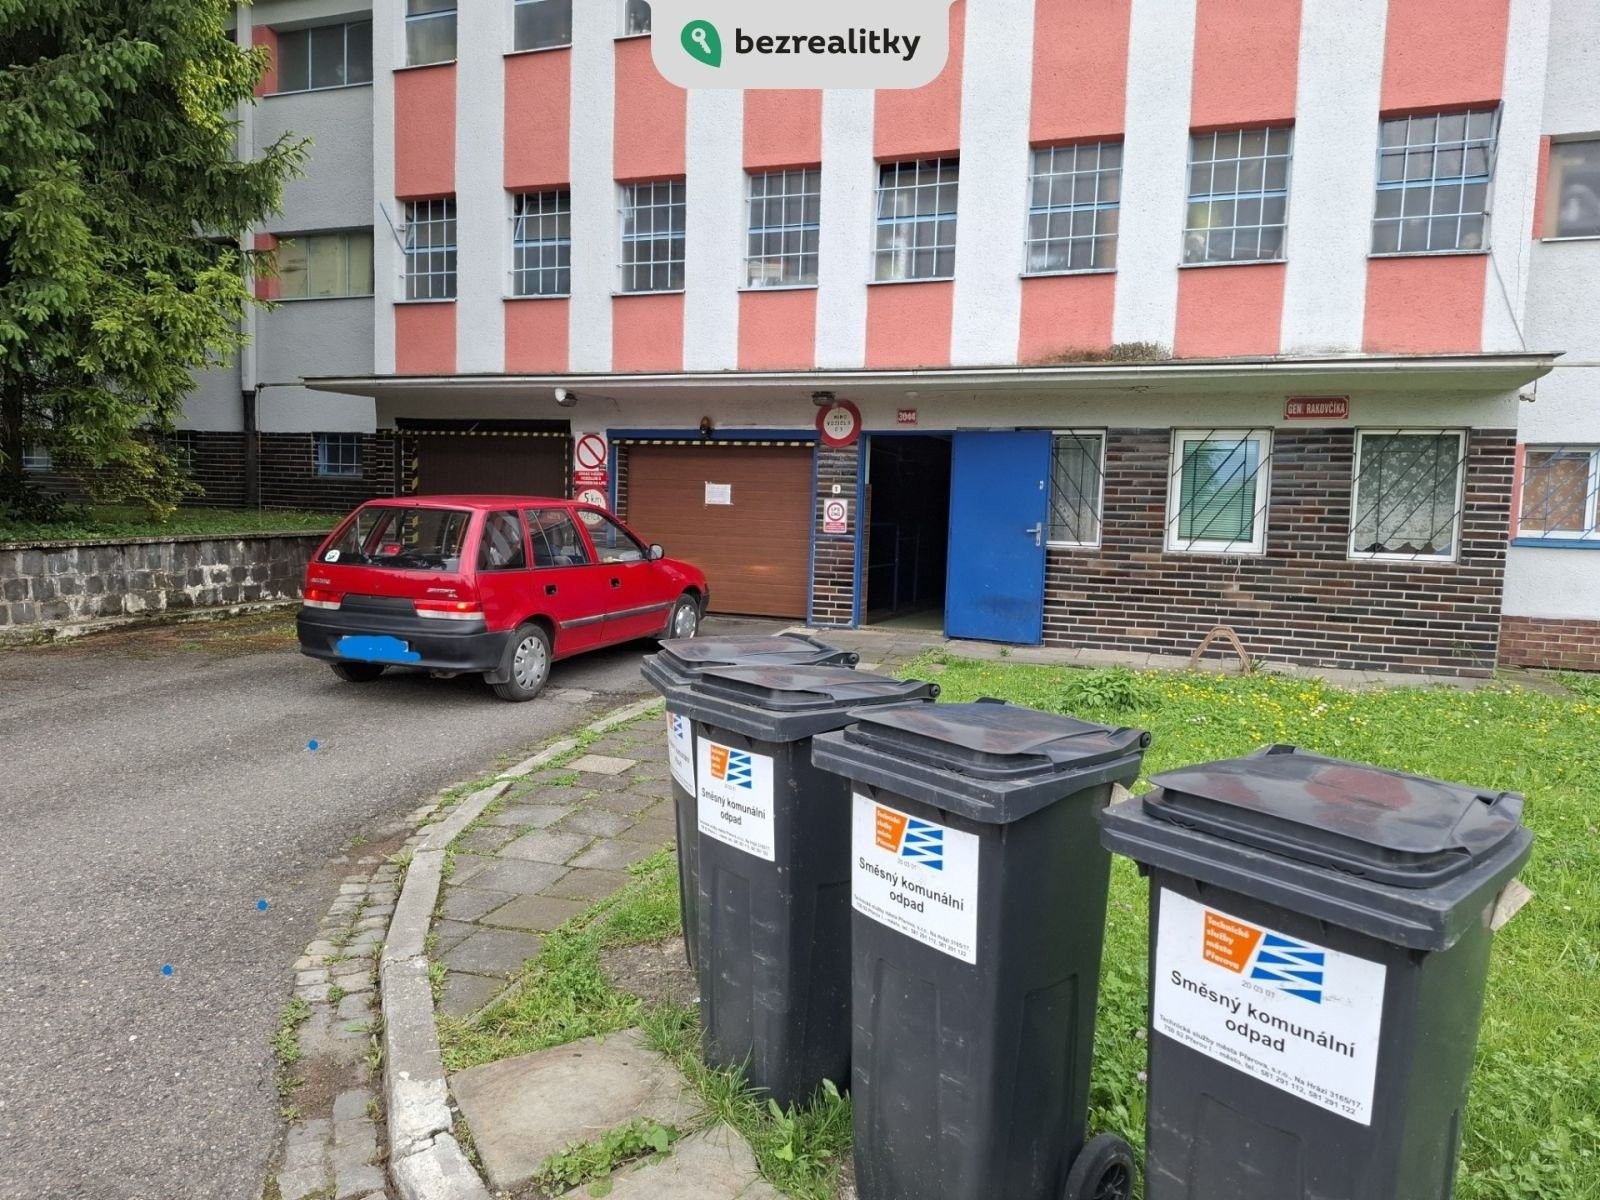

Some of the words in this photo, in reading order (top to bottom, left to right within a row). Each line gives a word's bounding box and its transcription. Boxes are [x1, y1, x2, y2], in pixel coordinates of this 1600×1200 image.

[898, 411, 916, 422] 3044
[1288, 403, 1304, 414] GEN.
[1306, 401, 1346, 414] RAKOVČÍKA
[701, 787, 726, 808] Směsný
[727, 797, 766, 820] komunální
[720, 811, 742, 825] odpad
[859, 856, 898, 887] Směsný
[901, 875, 964, 911] komunální
[889, 891, 924, 913] odpad
[1206, 927, 1235, 946] služby
[1206, 949, 1240, 970] Přerova
[1241, 979, 1252, 990] 20
[1170, 970, 1242, 1014] Směsný
[1247, 1003, 1356, 1058] komunální
[1225, 1019, 1286, 1053] odpad
[1294, 1075, 1305, 1085] Na
[1306, 1080, 1328, 1095] Hrázi
[1341, 1103, 1356, 1115] 122
